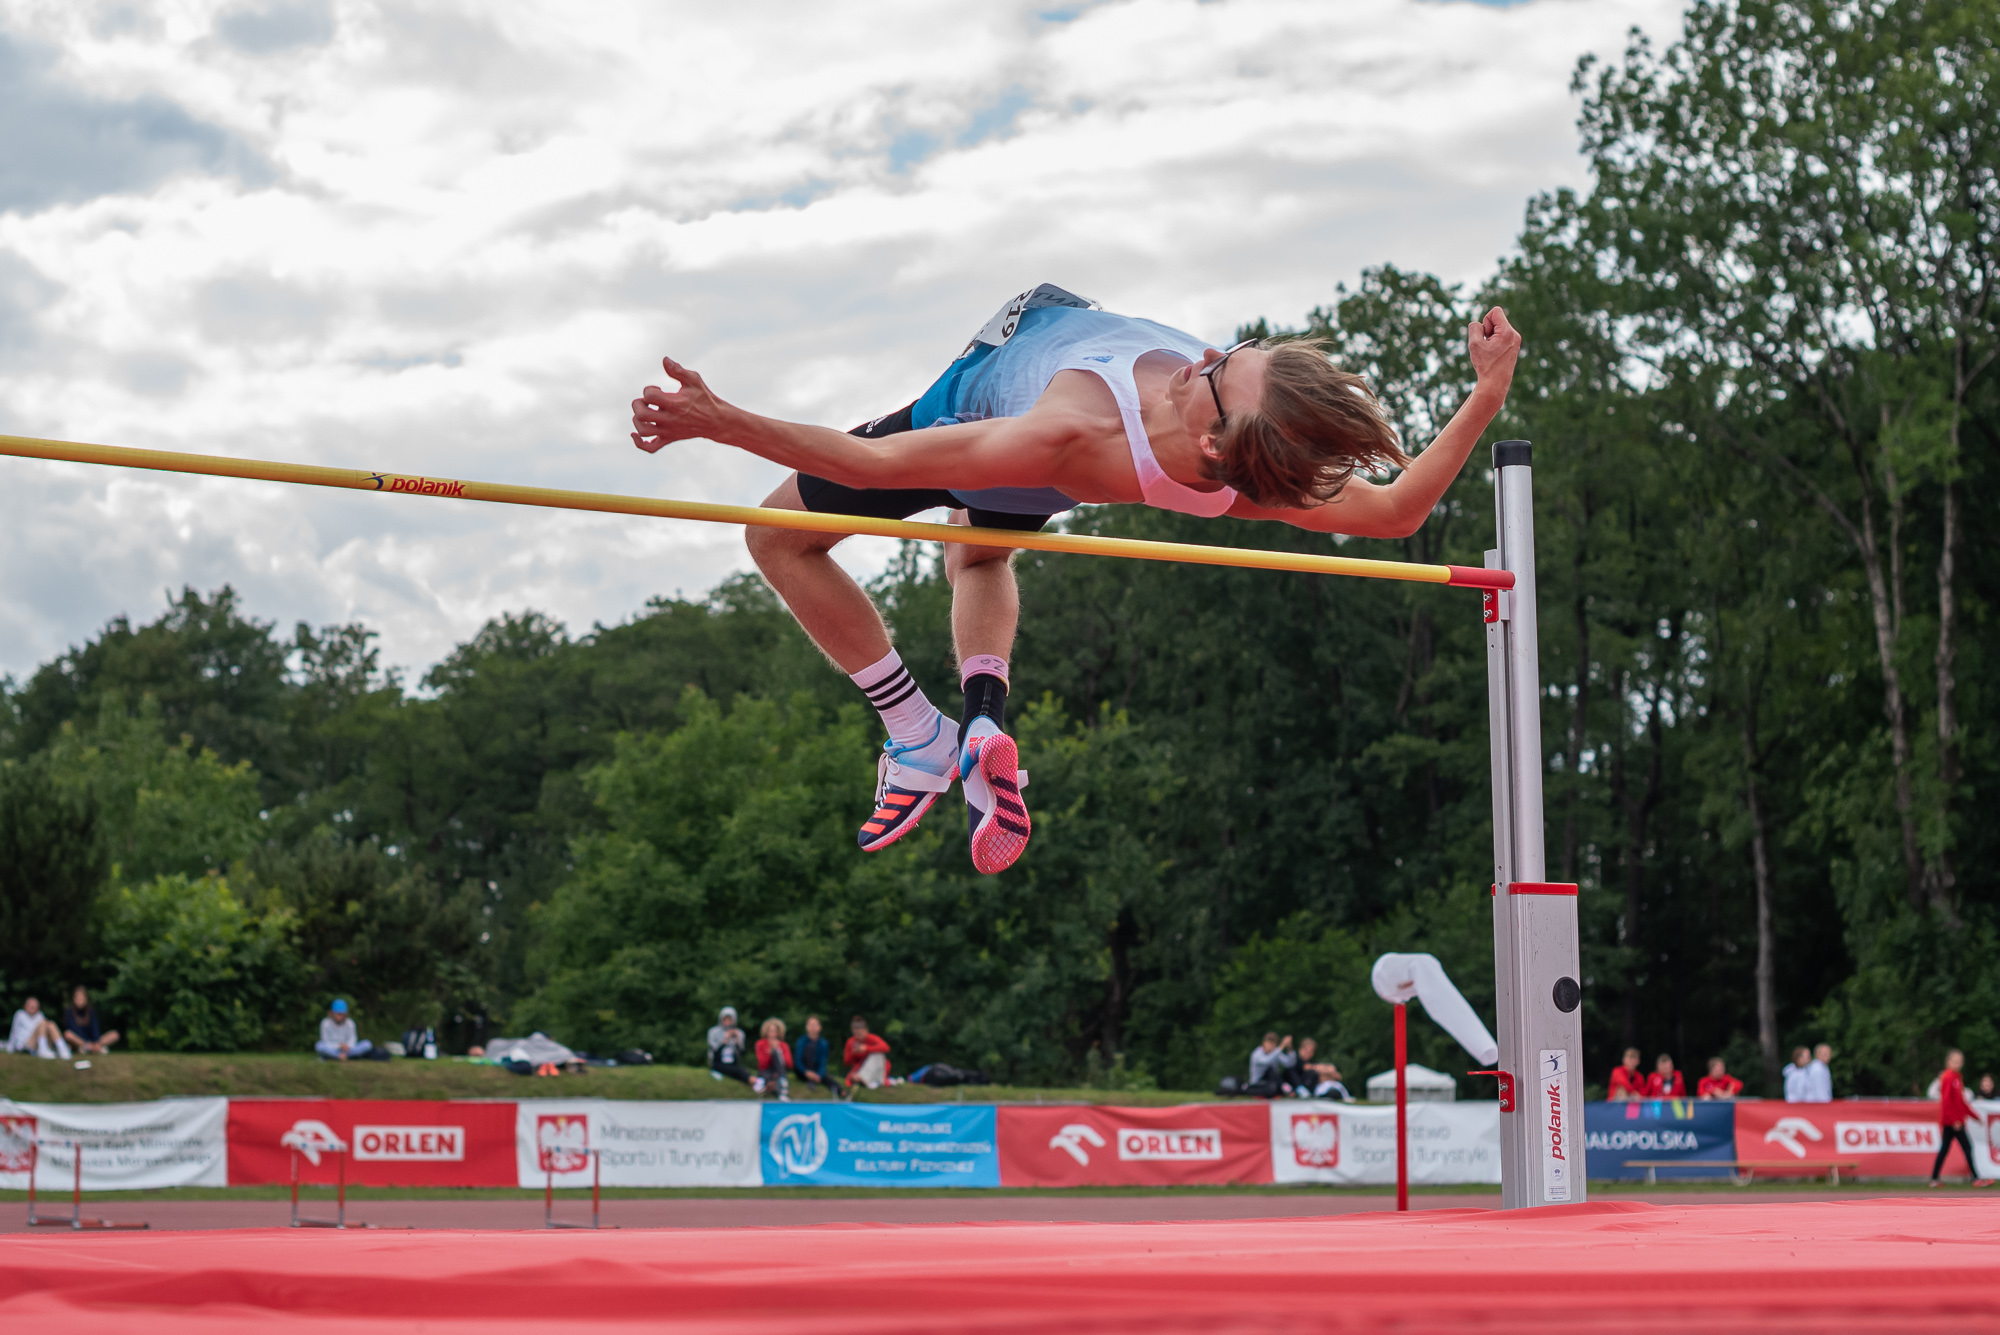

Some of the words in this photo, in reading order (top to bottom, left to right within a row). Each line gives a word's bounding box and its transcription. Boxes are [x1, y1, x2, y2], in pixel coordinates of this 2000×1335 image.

[389, 477, 466, 497] polanik
[1546, 1083, 1566, 1161] polanik
[601, 1124, 705, 1142] Ministerstwo
[1585, 1130, 1699, 1150] AŁOPOLSKA
[1843, 1129, 1933, 1147] ORLEN
[362, 1133, 456, 1154] ORLEN
[1126, 1135, 1214, 1154] ORLEN
[669, 1149, 744, 1169] Turystyki
